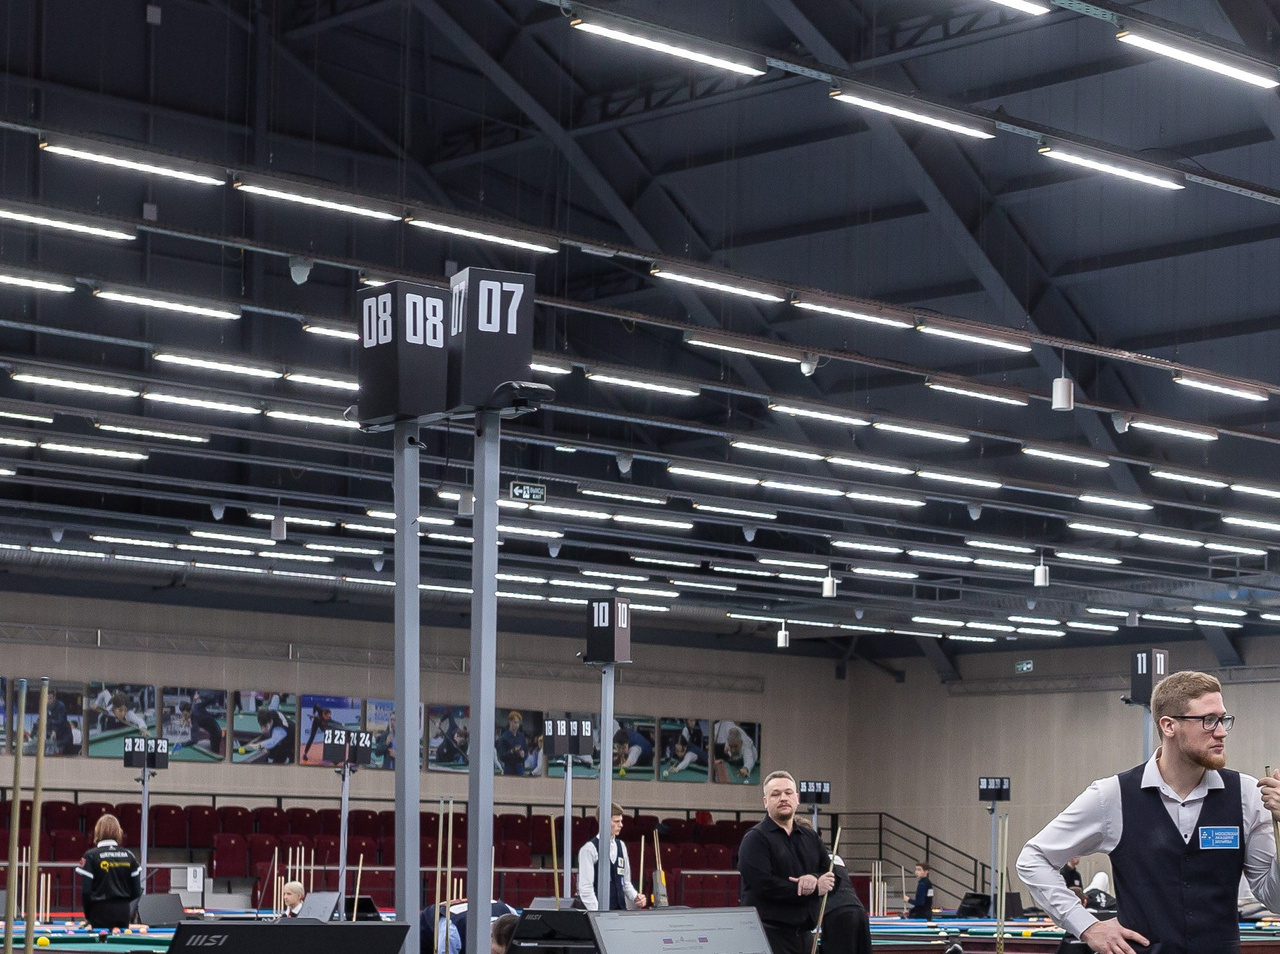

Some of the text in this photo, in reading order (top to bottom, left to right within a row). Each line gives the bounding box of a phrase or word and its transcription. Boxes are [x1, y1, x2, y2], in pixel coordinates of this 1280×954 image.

[451, 281, 465, 336] 07
[478, 280, 524, 334] 07
[363, 293, 392, 348] 08
[405, 293, 444, 348] 08
[593, 602, 609, 627] 10
[618, 602, 627, 628] 10
[1137, 653, 1146, 674] 11
[1156, 653, 1164, 674] 11
[334, 730, 346, 745] 23
[545, 720, 553, 736] 18
[557, 720, 566, 736] 18
[570, 721, 578, 736] 19
[582, 721, 591, 737] 19
[157, 739, 168, 753] 29
[359, 732, 370, 747] 24
